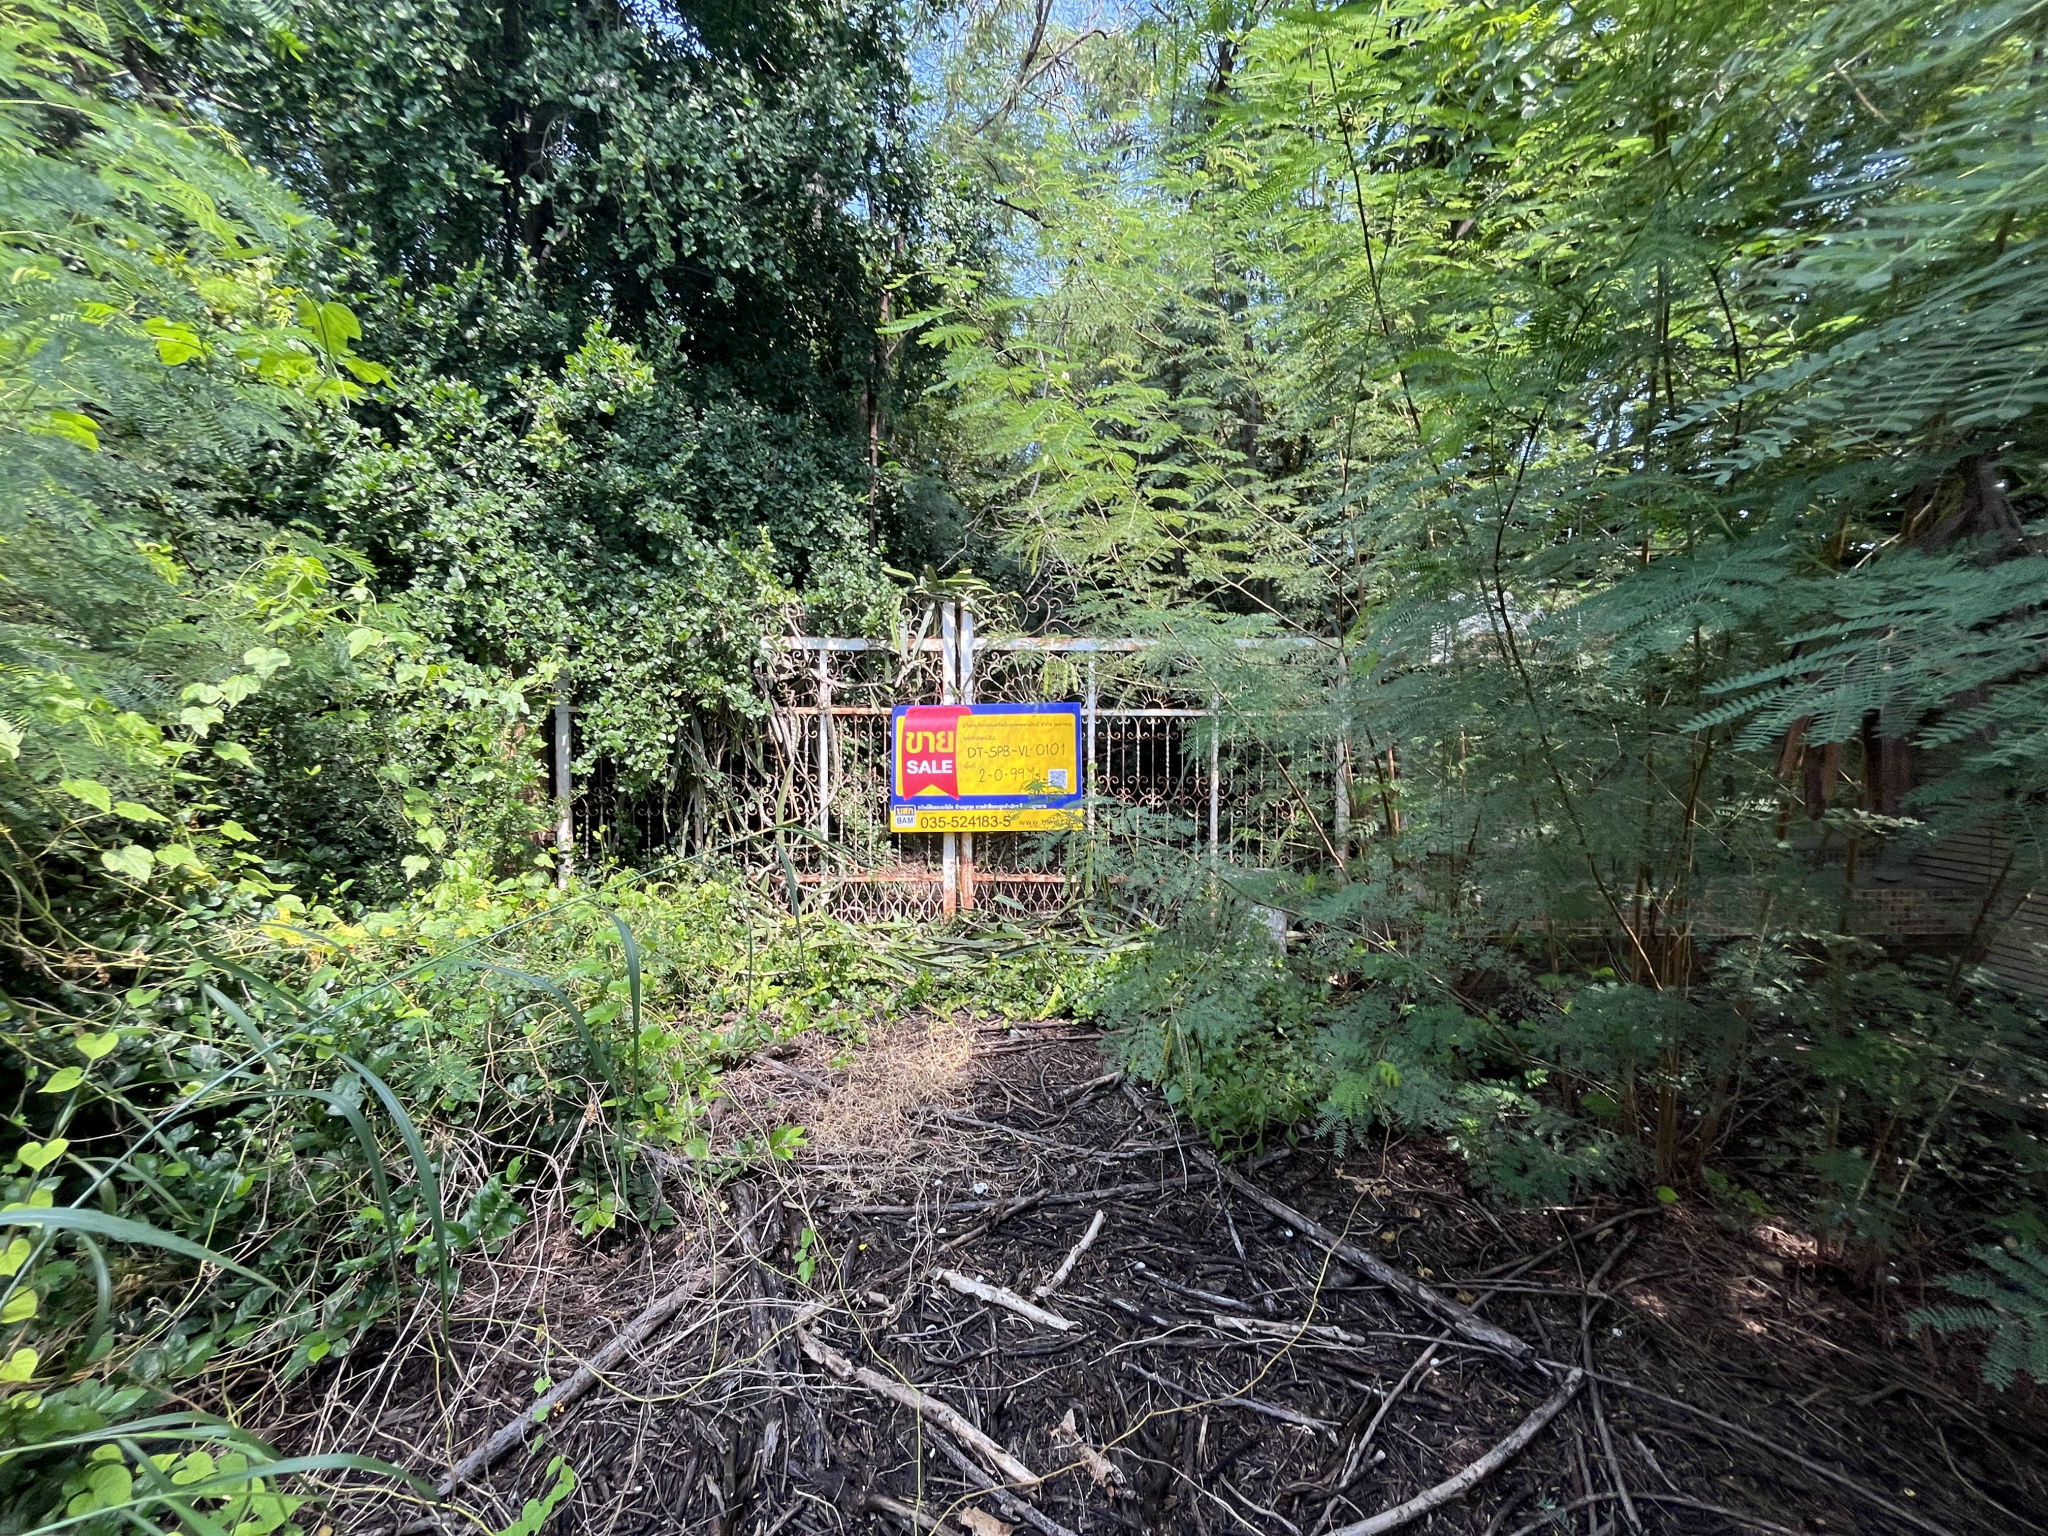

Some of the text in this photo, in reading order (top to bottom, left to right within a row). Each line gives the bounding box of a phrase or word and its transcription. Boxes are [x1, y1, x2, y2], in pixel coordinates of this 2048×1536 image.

[905, 730, 955, 754] ขาย
[906, 759, 954, 775] SALE
[896, 816, 914, 825] BAM
[921, 815, 1011, 829] 035-524183-5
